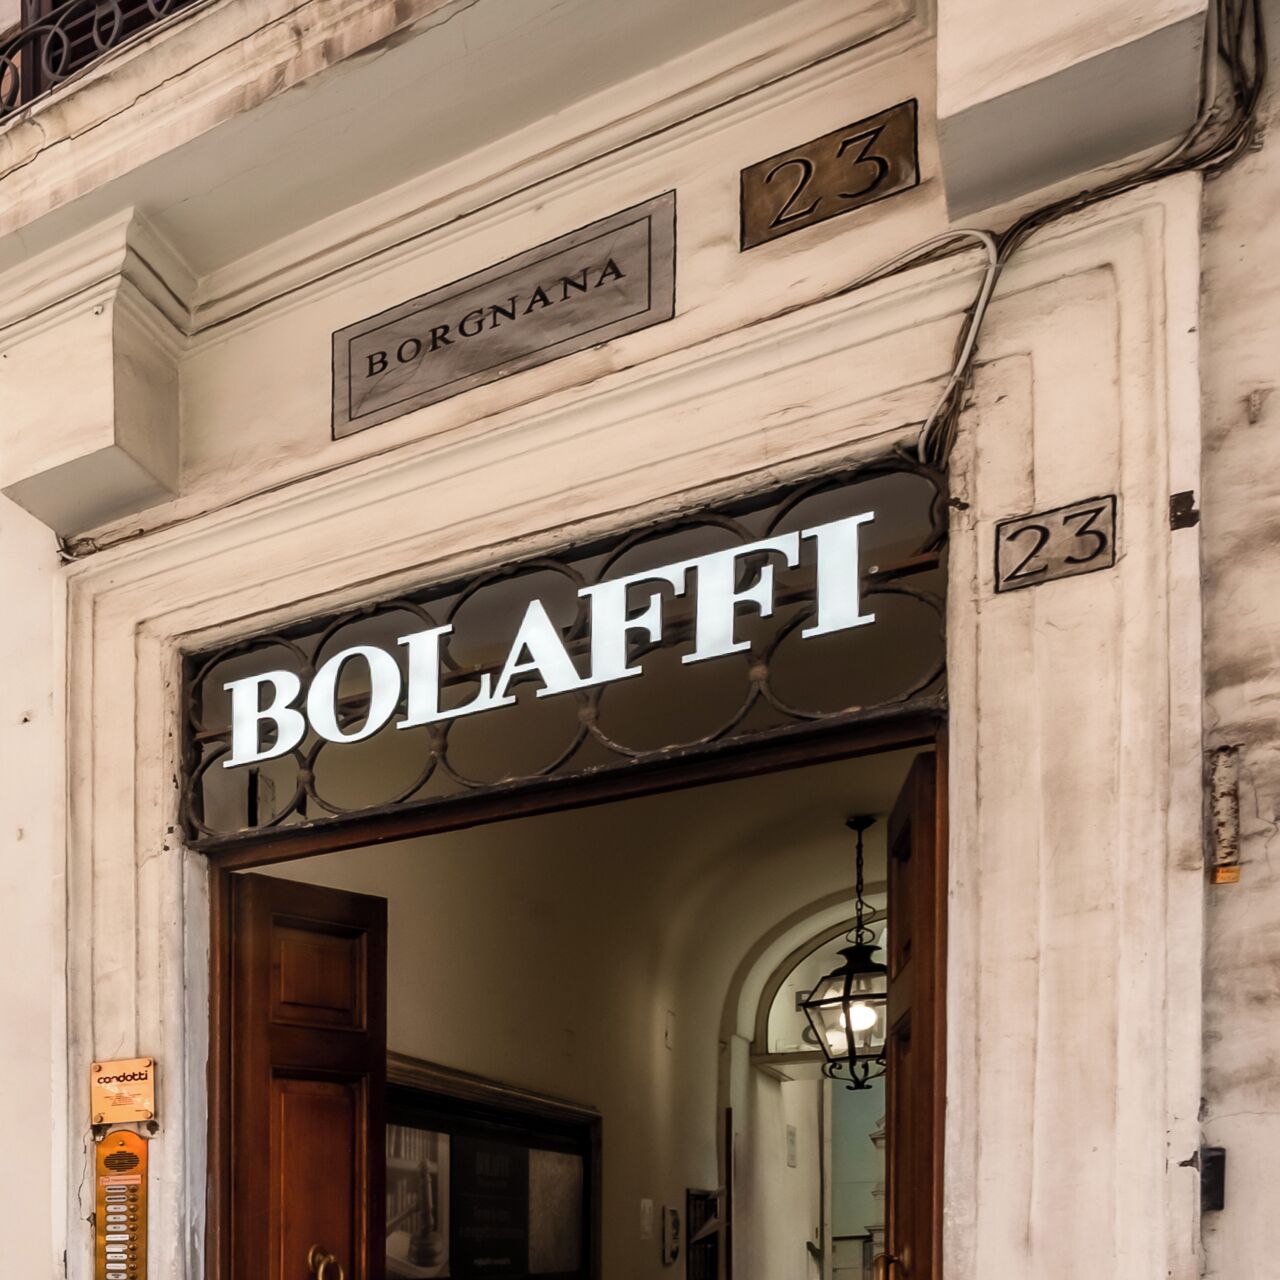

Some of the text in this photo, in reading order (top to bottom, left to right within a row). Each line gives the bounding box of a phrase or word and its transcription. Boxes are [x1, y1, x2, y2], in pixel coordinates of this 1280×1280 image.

[765, 124, 891, 229] 23
[365, 257, 626, 377] BORGNANA
[1004, 508, 1111, 578] 23
[222, 511, 877, 769] BOLAFFI
[97, 1070, 148, 1084] condotti
